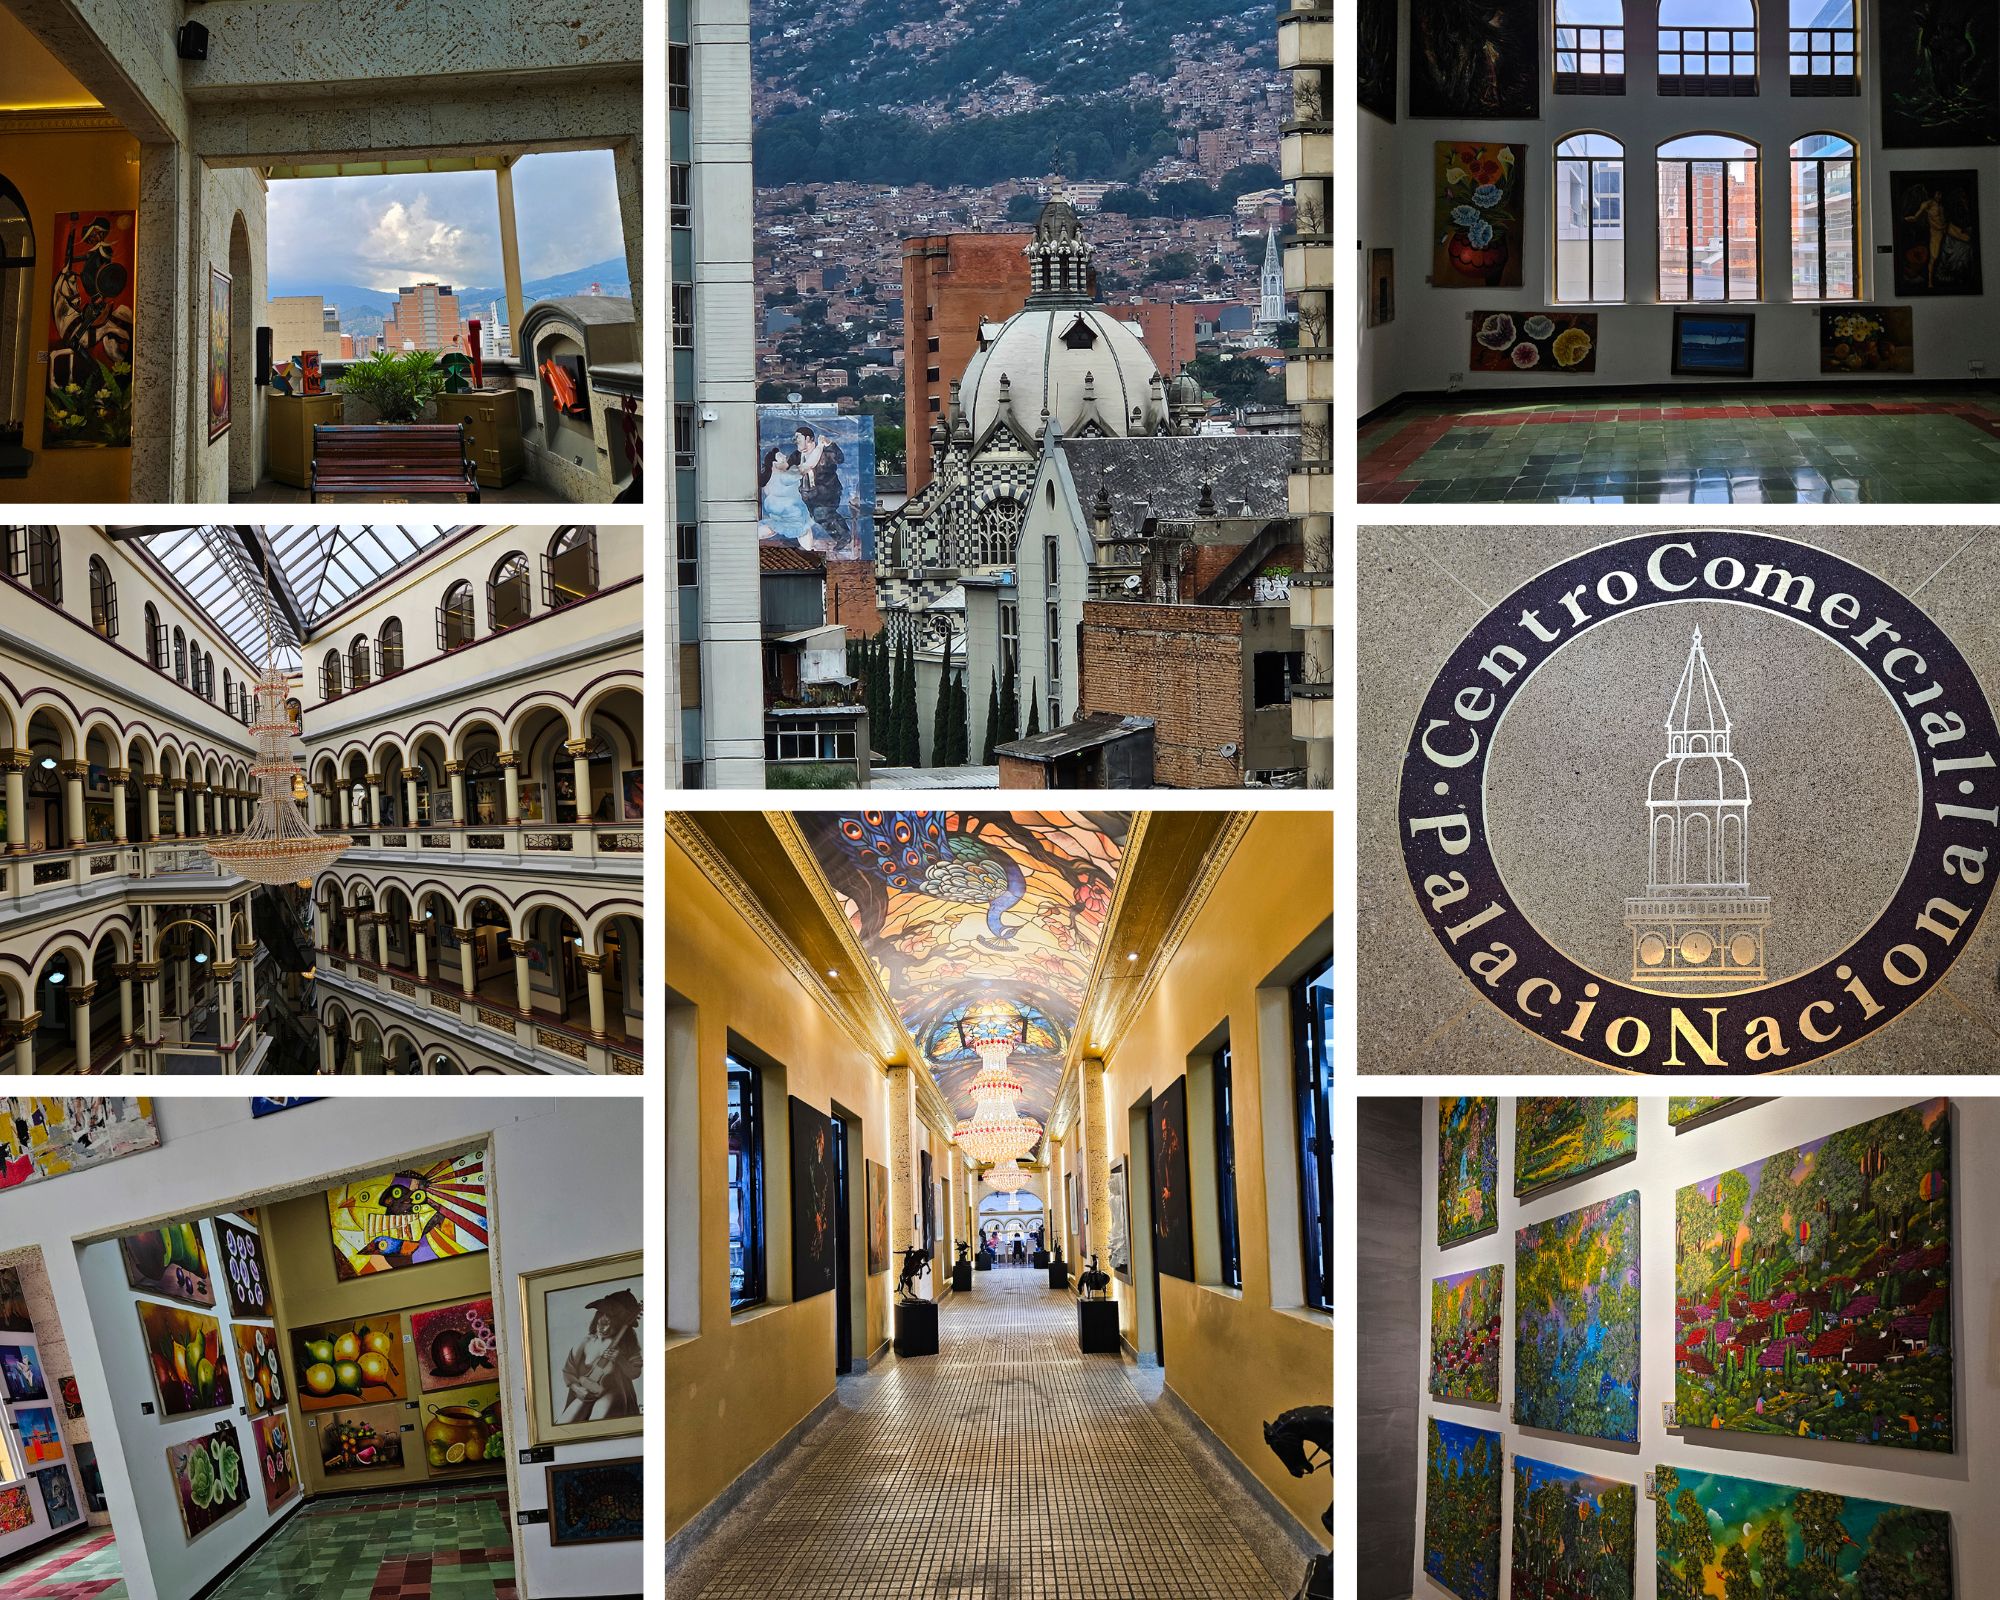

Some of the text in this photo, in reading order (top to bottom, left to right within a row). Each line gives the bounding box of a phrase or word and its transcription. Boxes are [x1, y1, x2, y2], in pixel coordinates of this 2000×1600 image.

[1421, 541, 1997, 777] Centro Comercial
[1410, 801, 1999, 1067] Palacio Nacional
